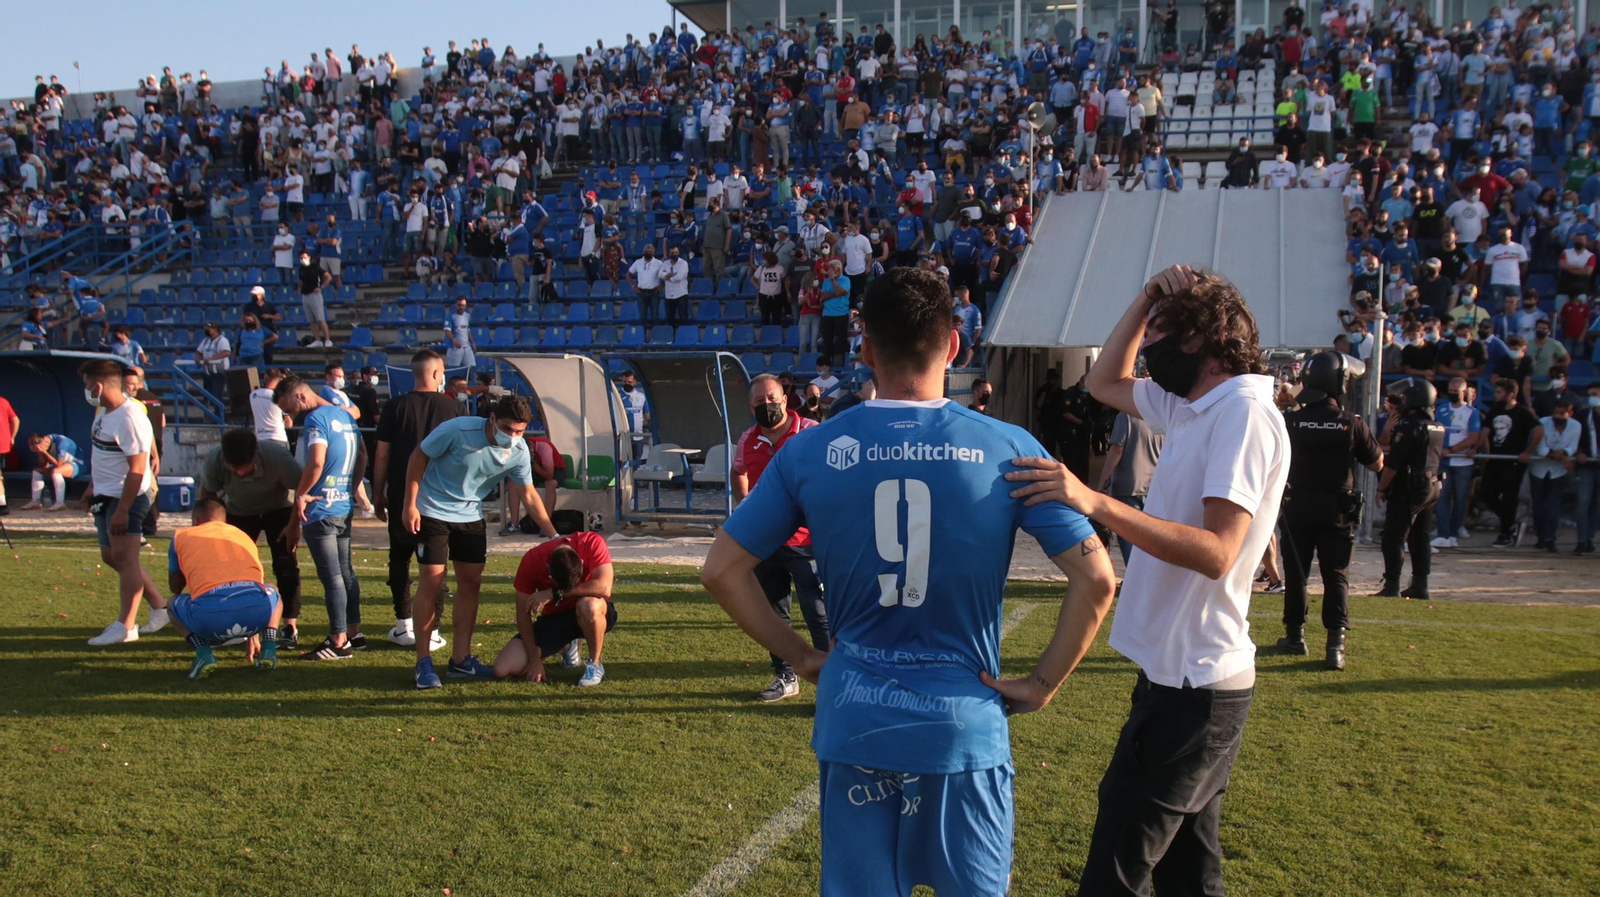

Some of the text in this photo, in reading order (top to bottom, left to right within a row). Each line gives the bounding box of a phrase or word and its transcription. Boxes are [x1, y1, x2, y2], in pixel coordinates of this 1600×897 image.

[1420, 209, 1437, 217] EA7
[1299, 421, 1344, 430] POLICIA
[342, 432, 358, 475] 11
[866, 442, 985, 463] duokitchen
[874, 478, 931, 608] 9
